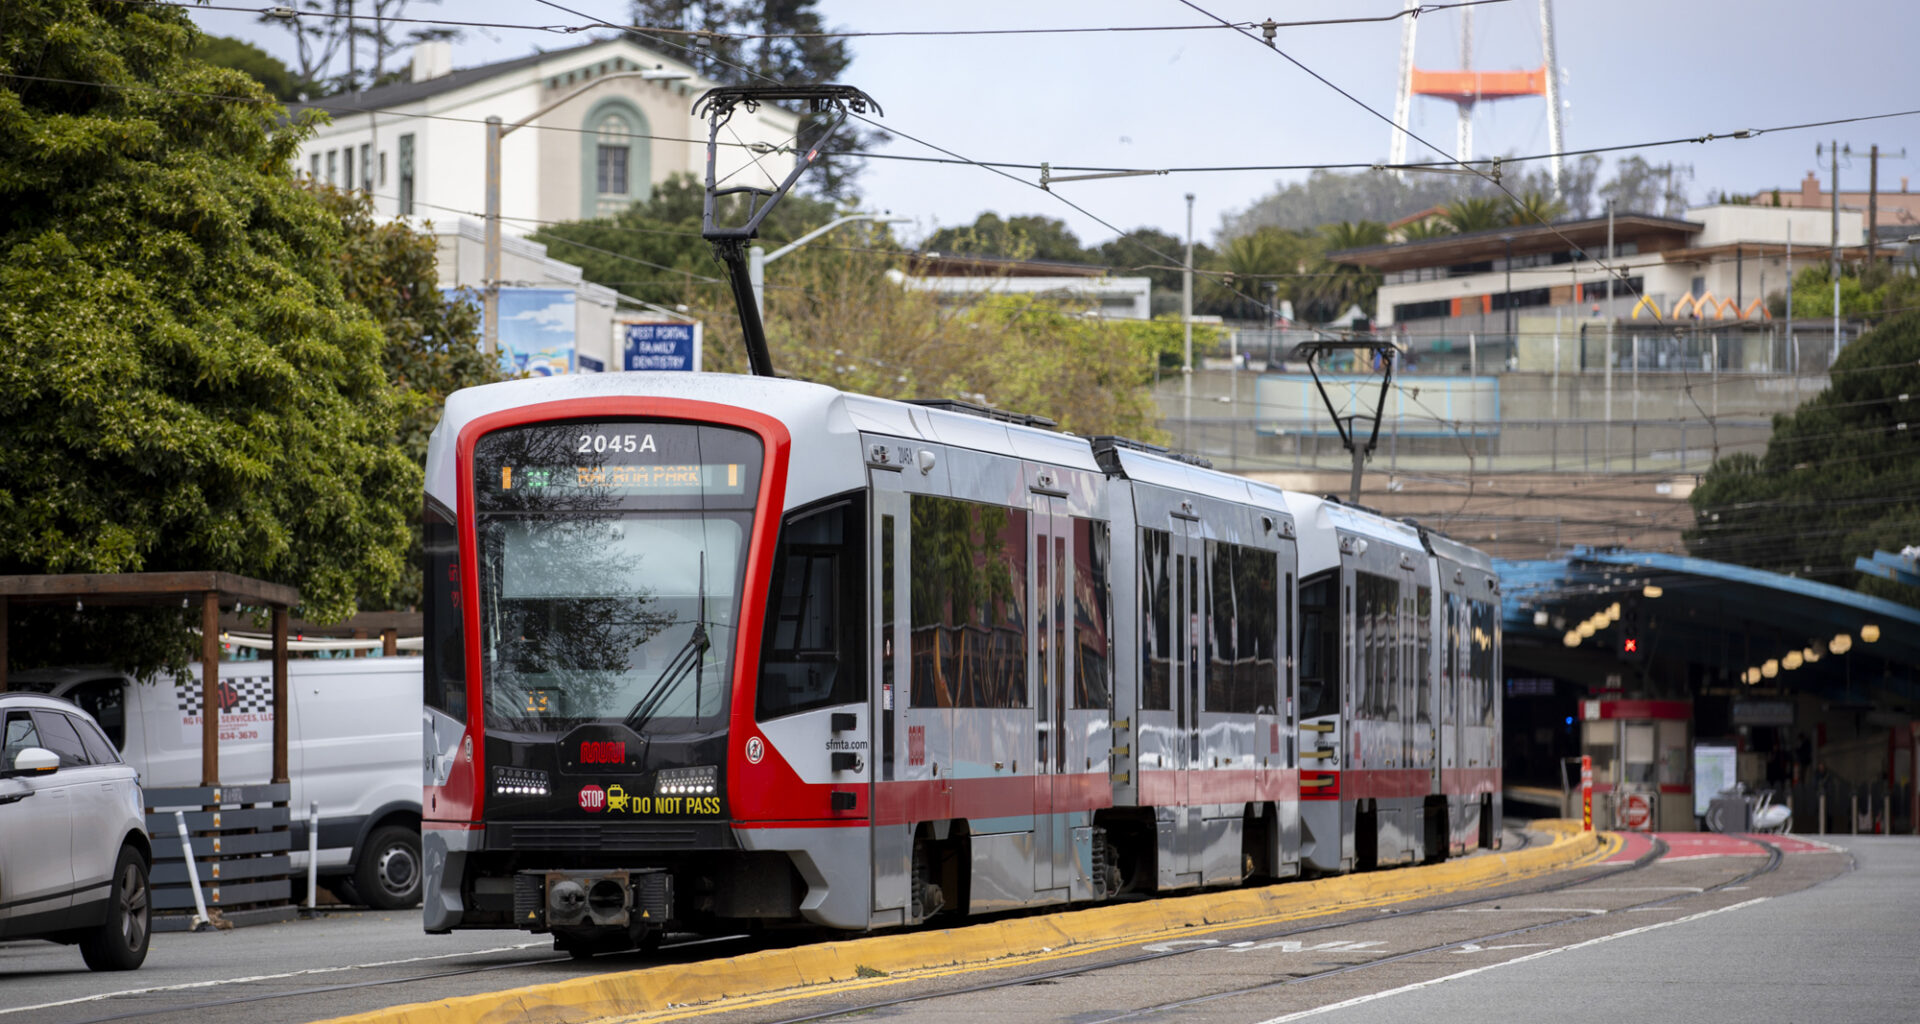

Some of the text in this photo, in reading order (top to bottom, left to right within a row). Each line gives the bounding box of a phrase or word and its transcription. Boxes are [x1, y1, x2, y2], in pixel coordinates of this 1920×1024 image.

[631, 326, 689, 340] WEST PORTAL
[639, 341, 677, 354] FAMILY
[632, 355, 686, 370] DENTISTRY
[578, 434, 657, 453] 2045A
[825, 739, 868, 750] sfmta.com
[580, 790, 605, 808] STOP
[632, 797, 721, 814] DO NOT PASS
